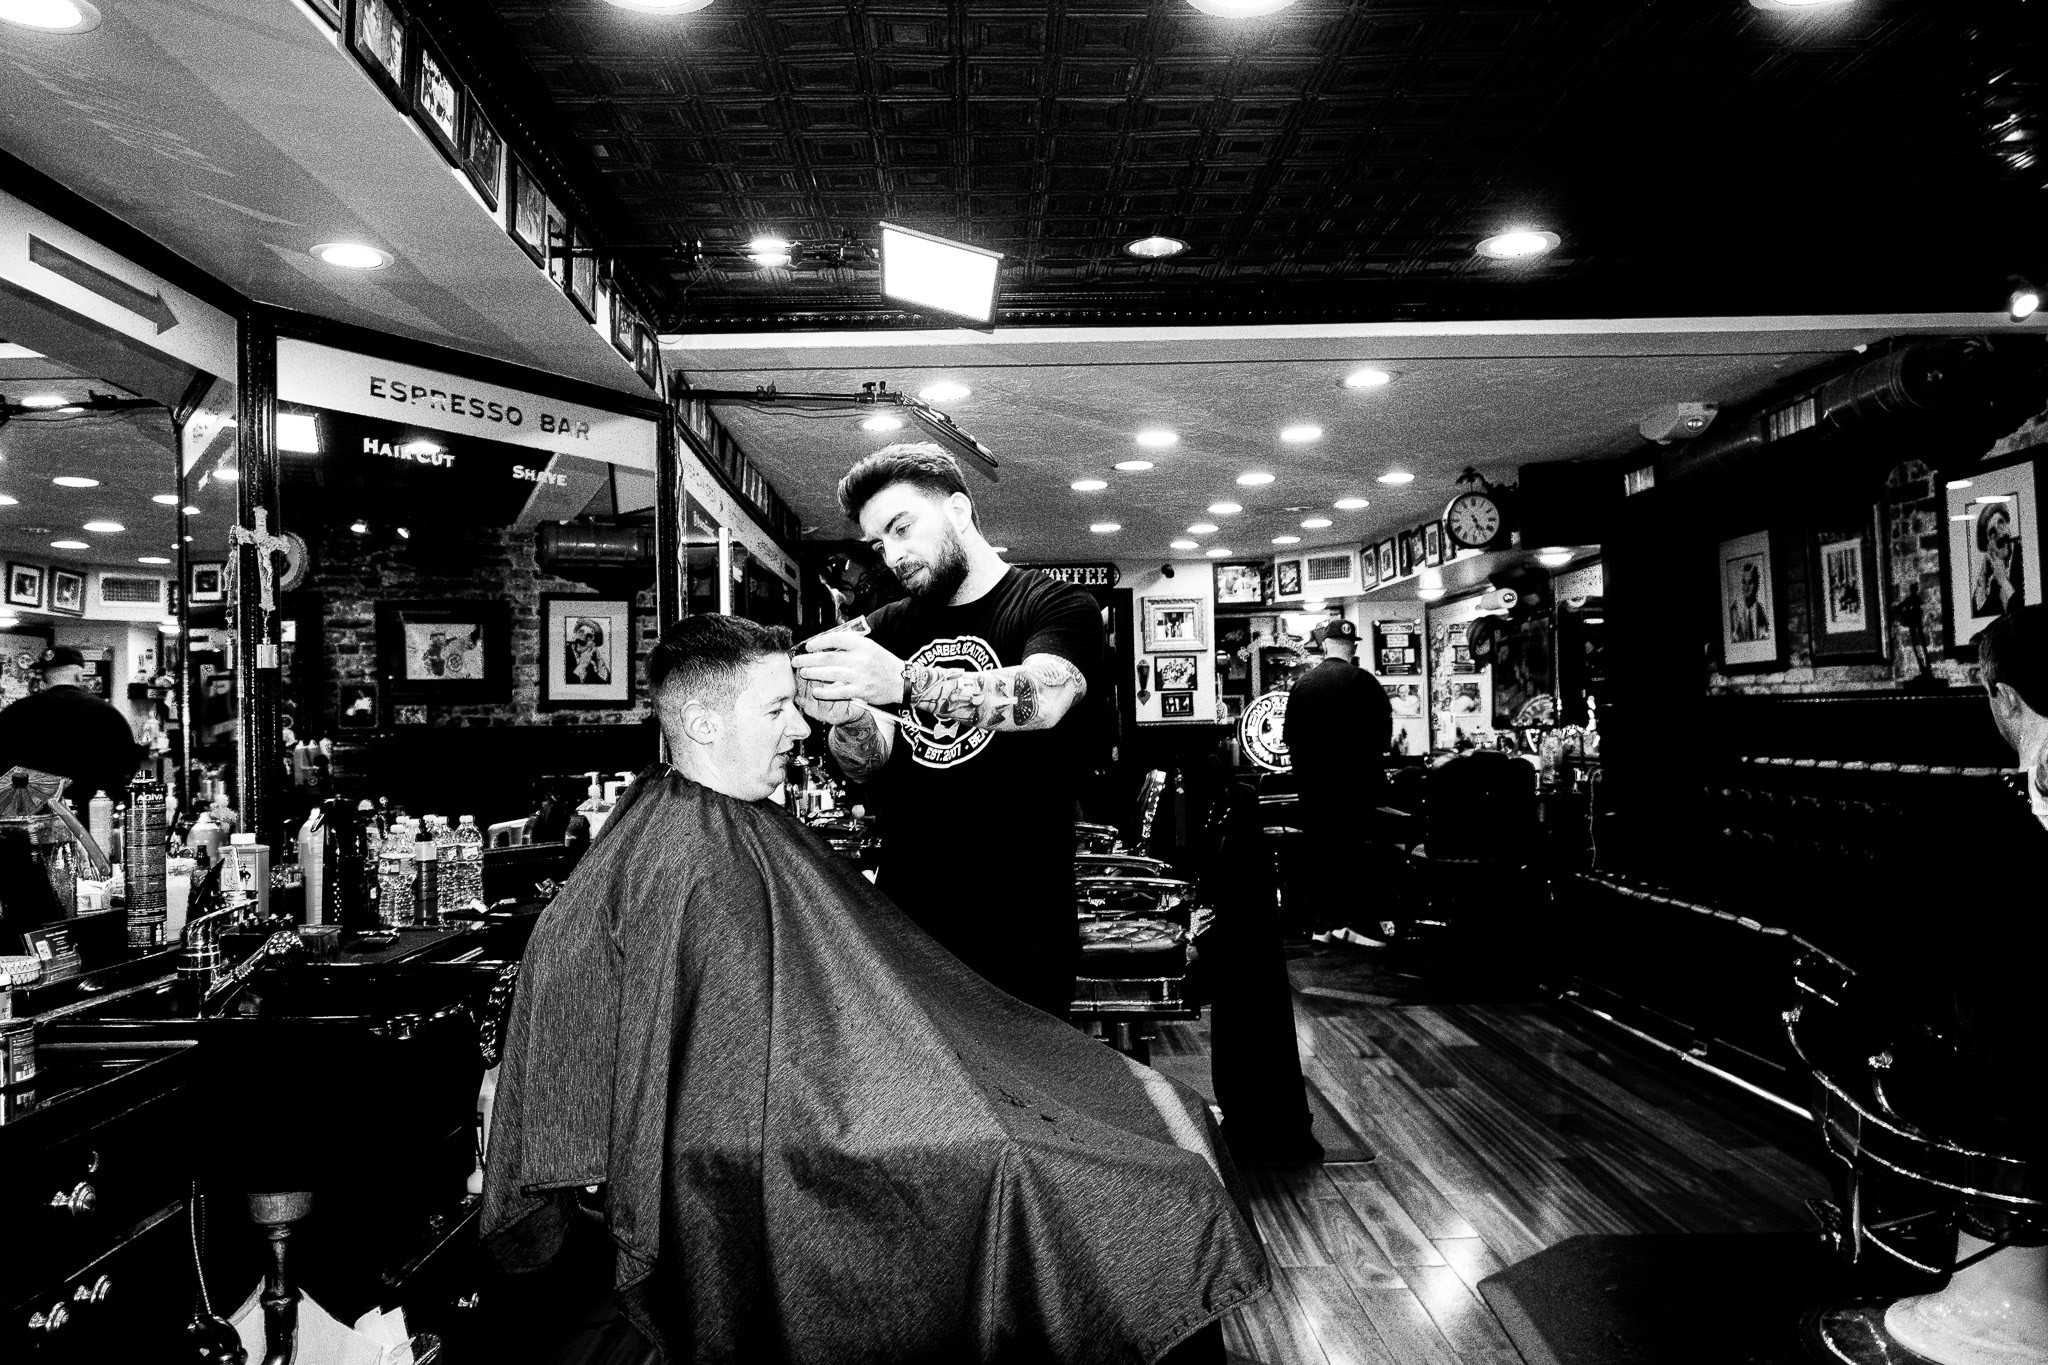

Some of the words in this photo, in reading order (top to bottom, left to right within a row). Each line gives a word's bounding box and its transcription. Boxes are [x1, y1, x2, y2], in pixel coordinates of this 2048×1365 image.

[369, 376, 523, 426] ESPRESSO
[540, 413, 590, 440] BAR
[512, 465, 568, 487] SHAVE
